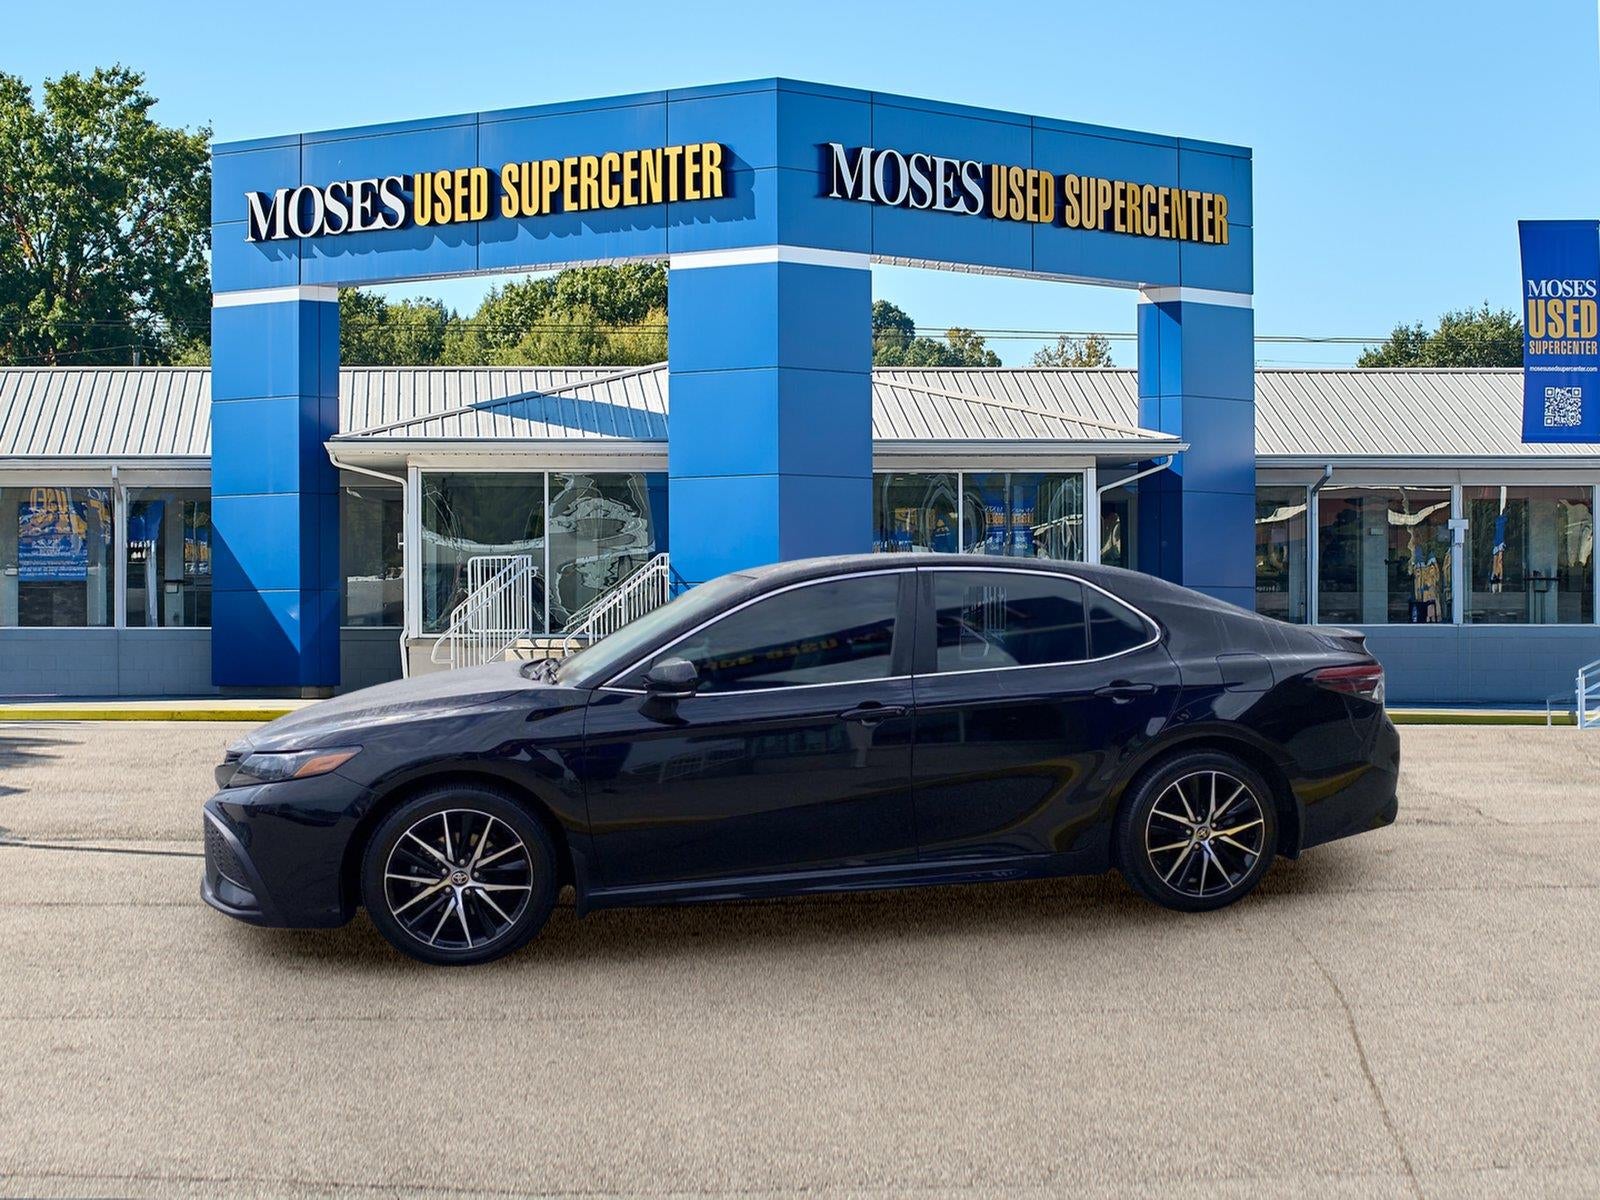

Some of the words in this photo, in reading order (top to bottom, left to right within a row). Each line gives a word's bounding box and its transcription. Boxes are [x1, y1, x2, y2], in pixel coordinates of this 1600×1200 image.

[244, 175, 406, 242] MOSES
[413, 166, 489, 226] USED
[501, 142, 724, 219] SUPERCENTER
[829, 142, 985, 216] MOSES
[991, 163, 1055, 224] USED
[1065, 173, 1230, 245] SUPERCENTER
[1527, 279, 1598, 298] MOSES
[1528, 299, 1598, 339] USED
[1529, 340, 1598, 356] SUPERCENTER
[1529, 365, 1598, 374] mosesusedsupercenter.com
